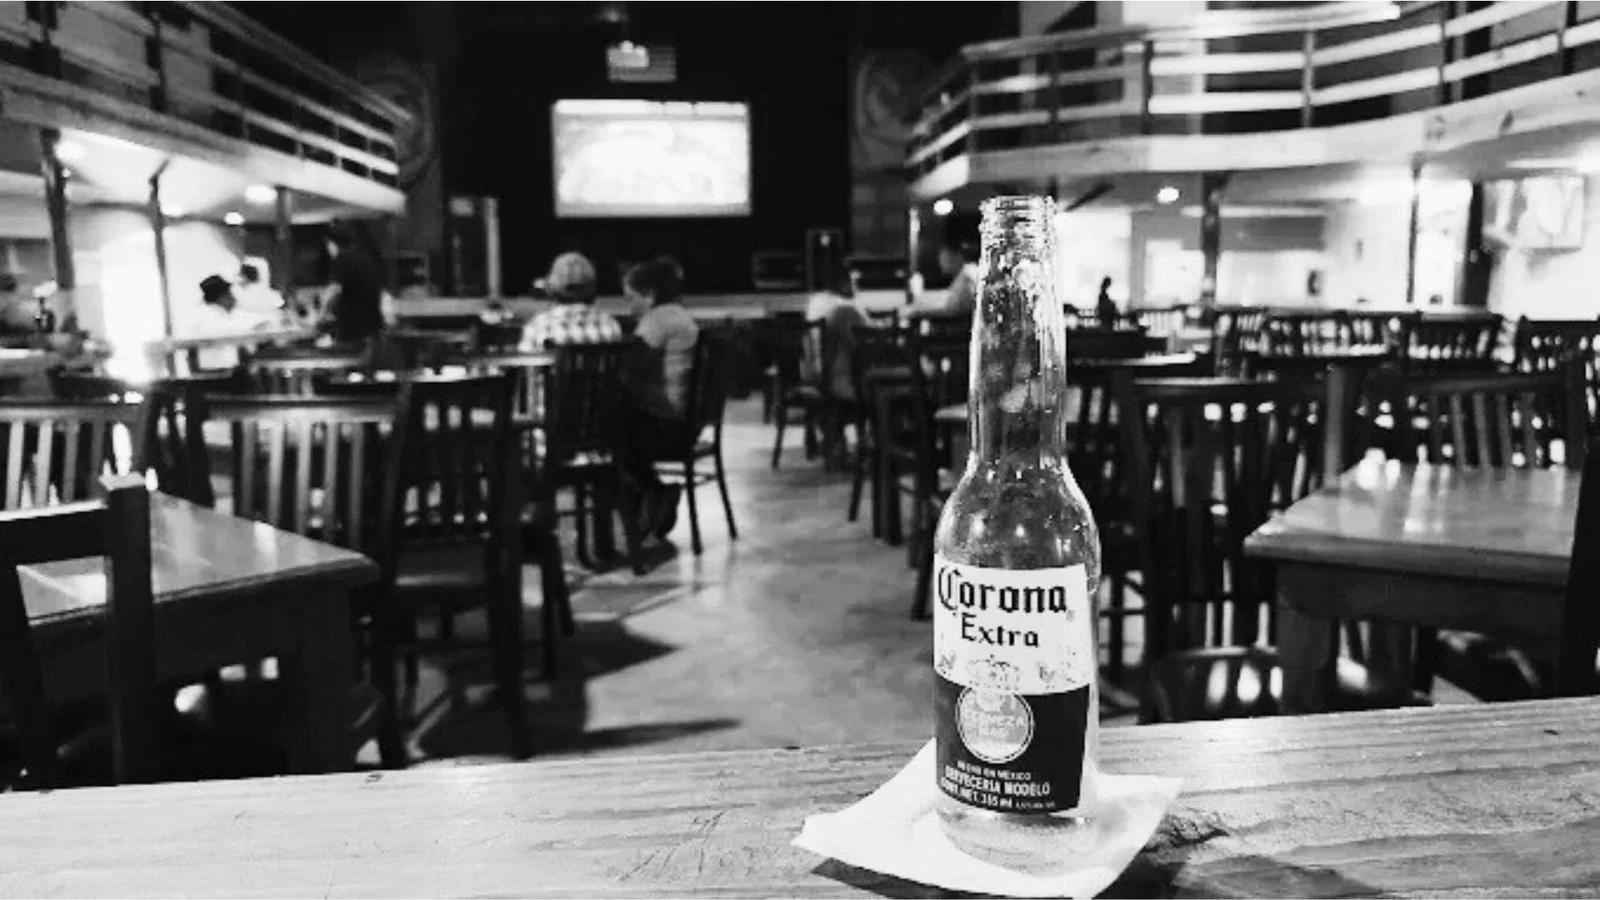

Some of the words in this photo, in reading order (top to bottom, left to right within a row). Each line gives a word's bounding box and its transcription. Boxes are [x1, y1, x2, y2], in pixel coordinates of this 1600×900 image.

[938, 566, 1067, 613] Corona
[961, 612, 1039, 647] Extra
[1003, 781, 1050, 797] MODELO
